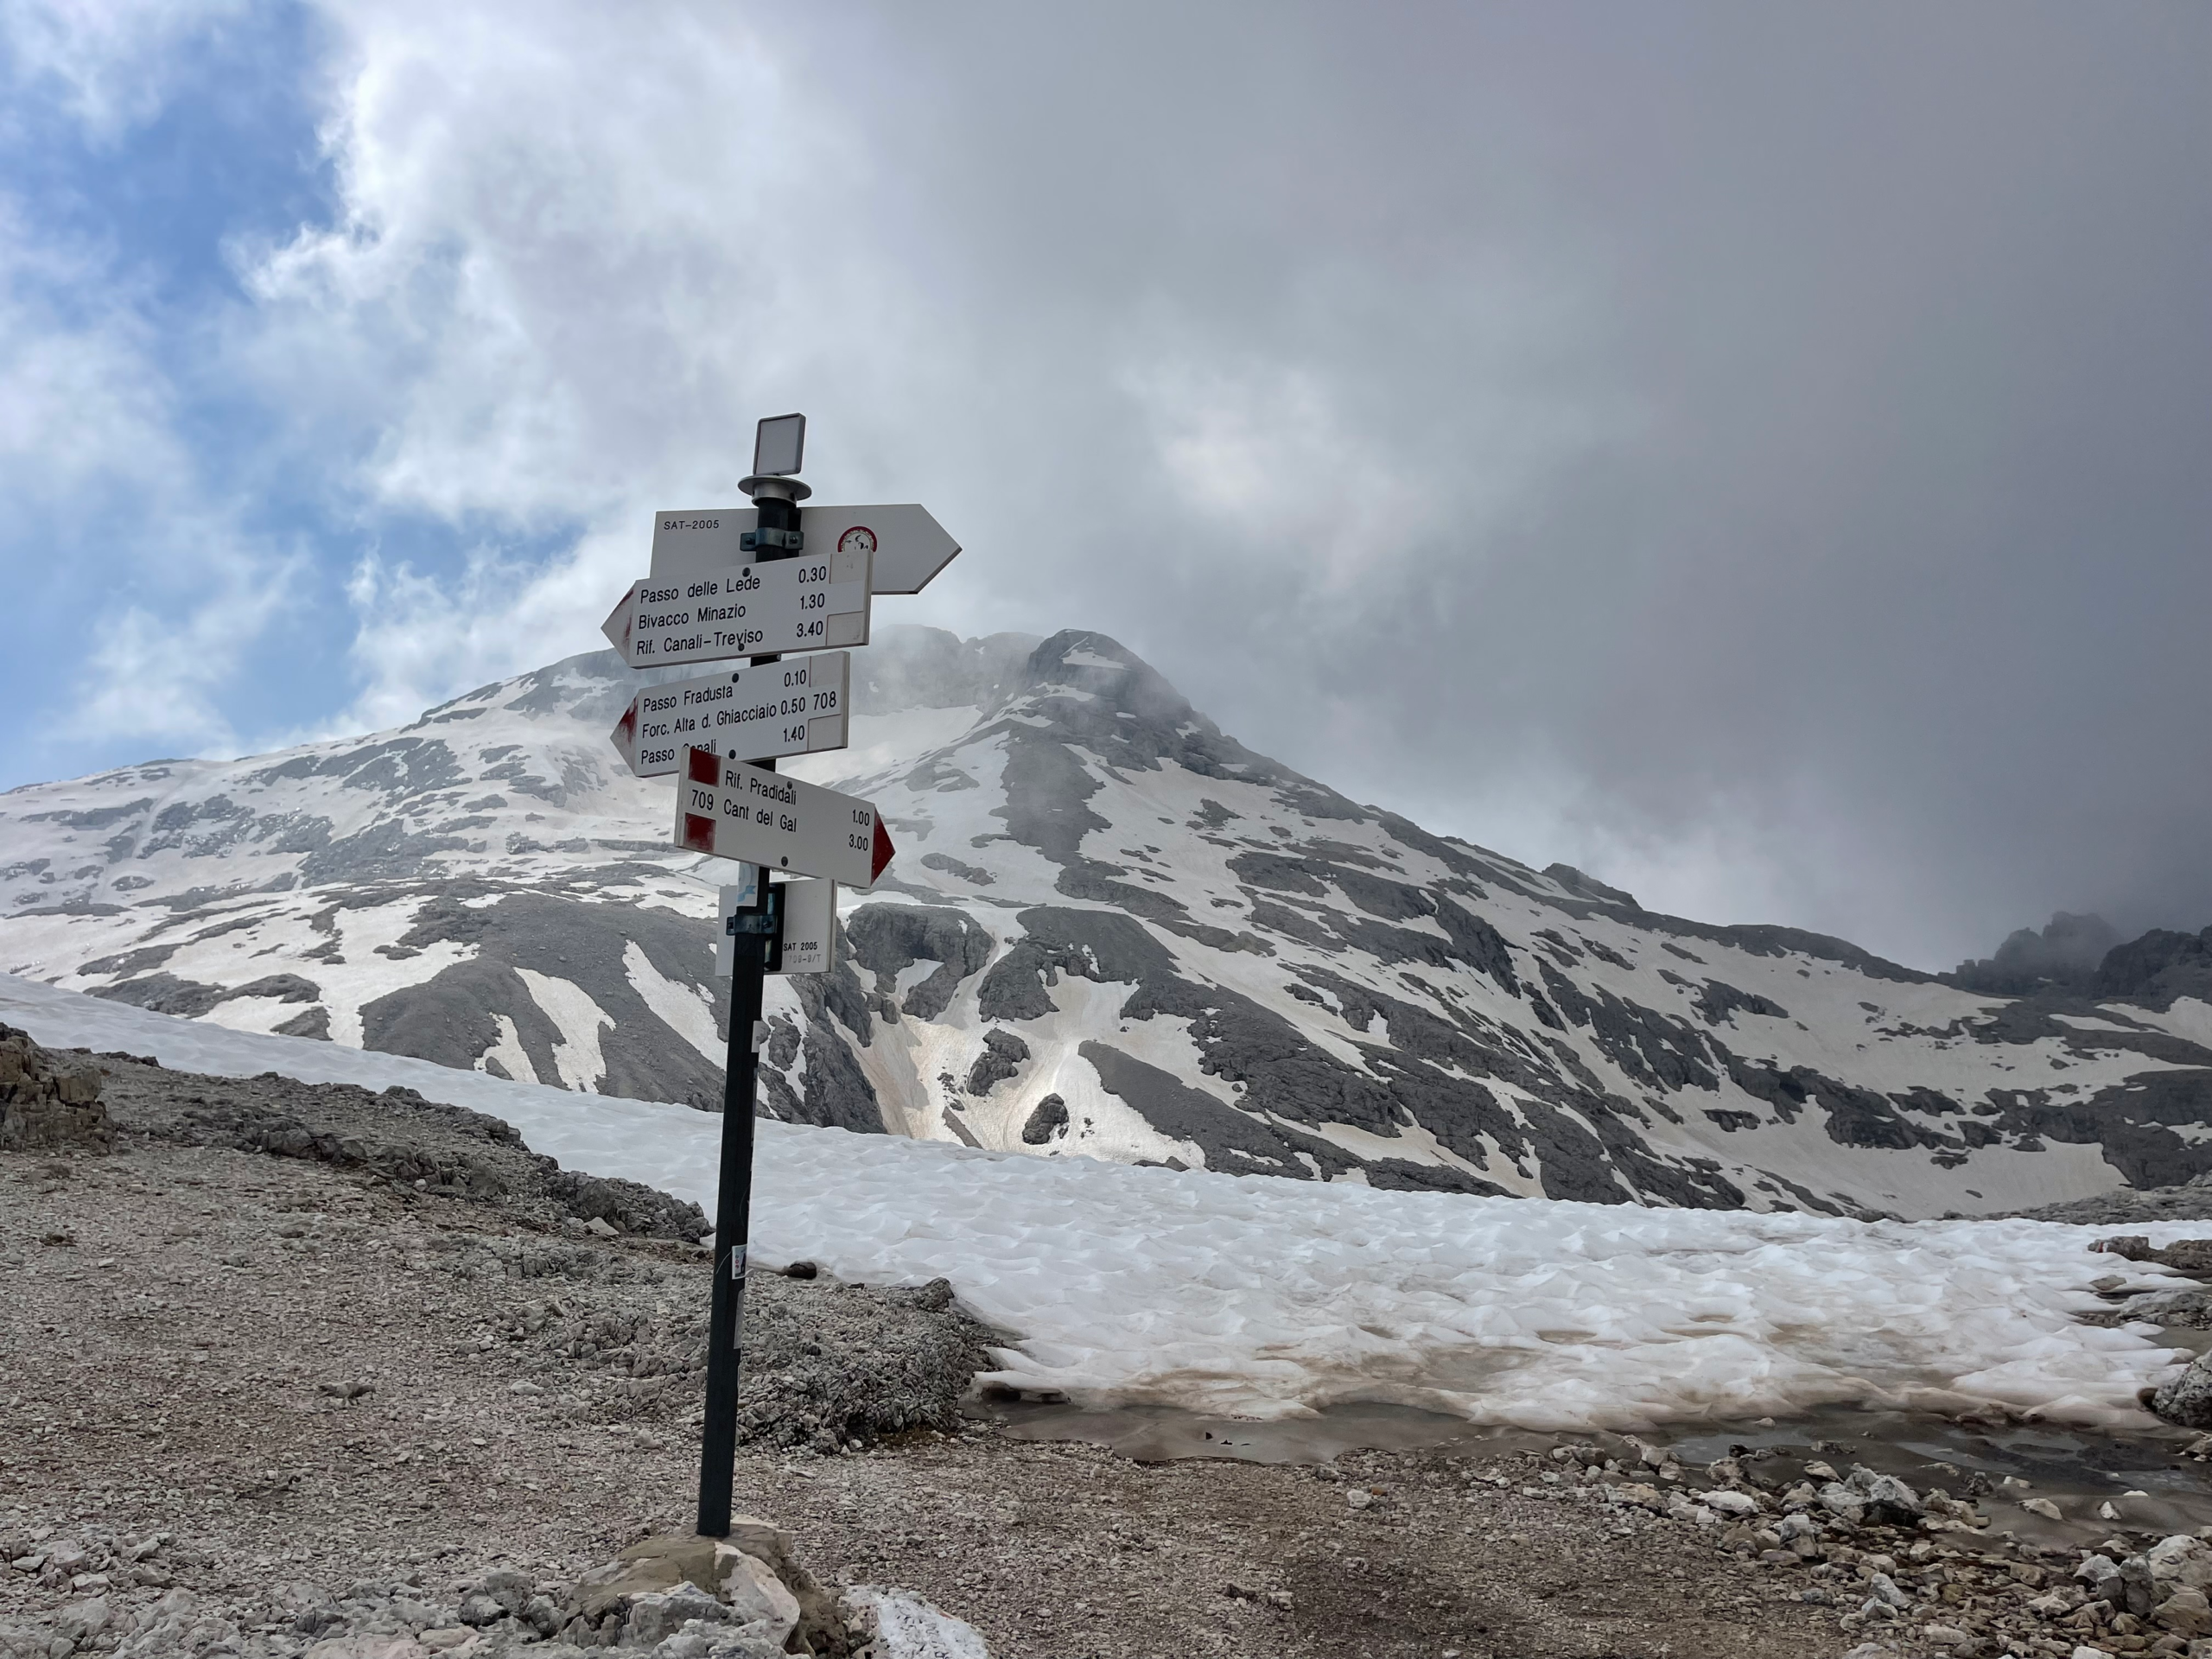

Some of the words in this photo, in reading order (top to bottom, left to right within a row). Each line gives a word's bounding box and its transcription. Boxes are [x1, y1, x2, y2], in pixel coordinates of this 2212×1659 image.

[664, 520, 719, 530] SAT-2005
[640, 588, 679, 604] Passo
[687, 581, 718, 598] delle
[726, 575, 760, 593] Lede
[798, 566, 827, 583] 0.30
[639, 612, 690, 629] Bivacco
[697, 603, 746, 622] Minazio
[800, 593, 825, 610] 1.30
[636, 639, 655, 655] Rif.
[796, 620, 823, 638] 3.40
[643, 696, 677, 713] Passo
[683, 685, 733, 706] Fradusta
[784, 670, 806, 687] 0.10
[642, 723, 670, 739] Forc.
[674, 717, 696, 734] Alta
[702, 713, 711, 728] d.
[716, 702, 777, 726] Ghiacciaio
[780, 696, 805, 715] 0.50
[813, 690, 836, 710] 708
[641, 748, 675, 765] Passo
[683, 738, 716, 753] nali
[783, 725, 805, 742] 1.40
[691, 789, 714, 810] 709
[725, 770, 743, 790] Rif.
[750, 778, 797, 805] Pradidali
[852, 809, 870, 827] 1.00
[723, 798, 750, 820] Cant
[756, 809, 773, 826] del
[779, 814, 797, 832] Gal
[849, 833, 868, 851] 3.00
[783, 942, 797, 951] SAT
[800, 941, 818, 951] 2005
